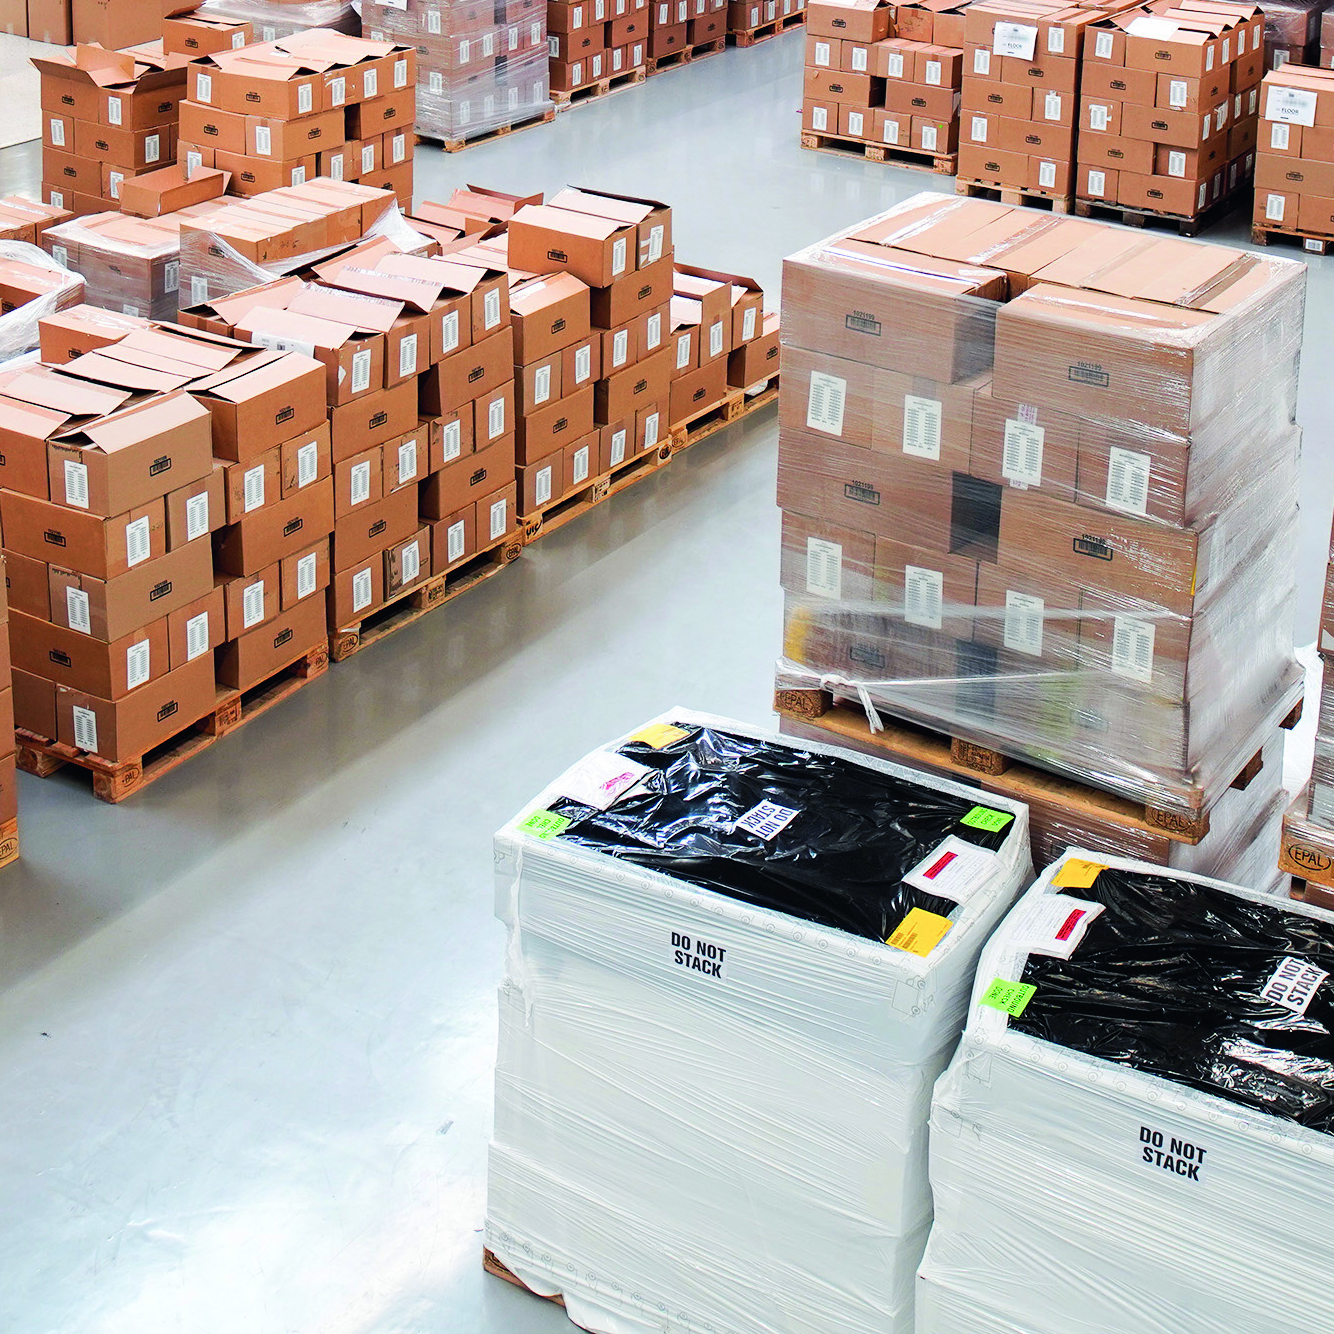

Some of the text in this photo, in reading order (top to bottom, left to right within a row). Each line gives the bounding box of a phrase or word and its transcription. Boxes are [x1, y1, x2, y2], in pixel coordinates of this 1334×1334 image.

[1281, 107, 1299, 115] FLOOR
[740, 804, 776, 828] STACK
[757, 807, 794, 838] DO NOT
[1295, 849, 1323, 867] EPAL
[670, 931, 727, 963] DO NOT
[673, 950, 723, 979] STACK
[1265, 959, 1306, 1004] DO NOT
[1287, 964, 1322, 1007] STACK
[1007, 985, 1031, 1014] OUTBOUND
[1139, 1126, 1208, 1165] DO NOT
[1141, 1145, 1201, 1182] STACK
